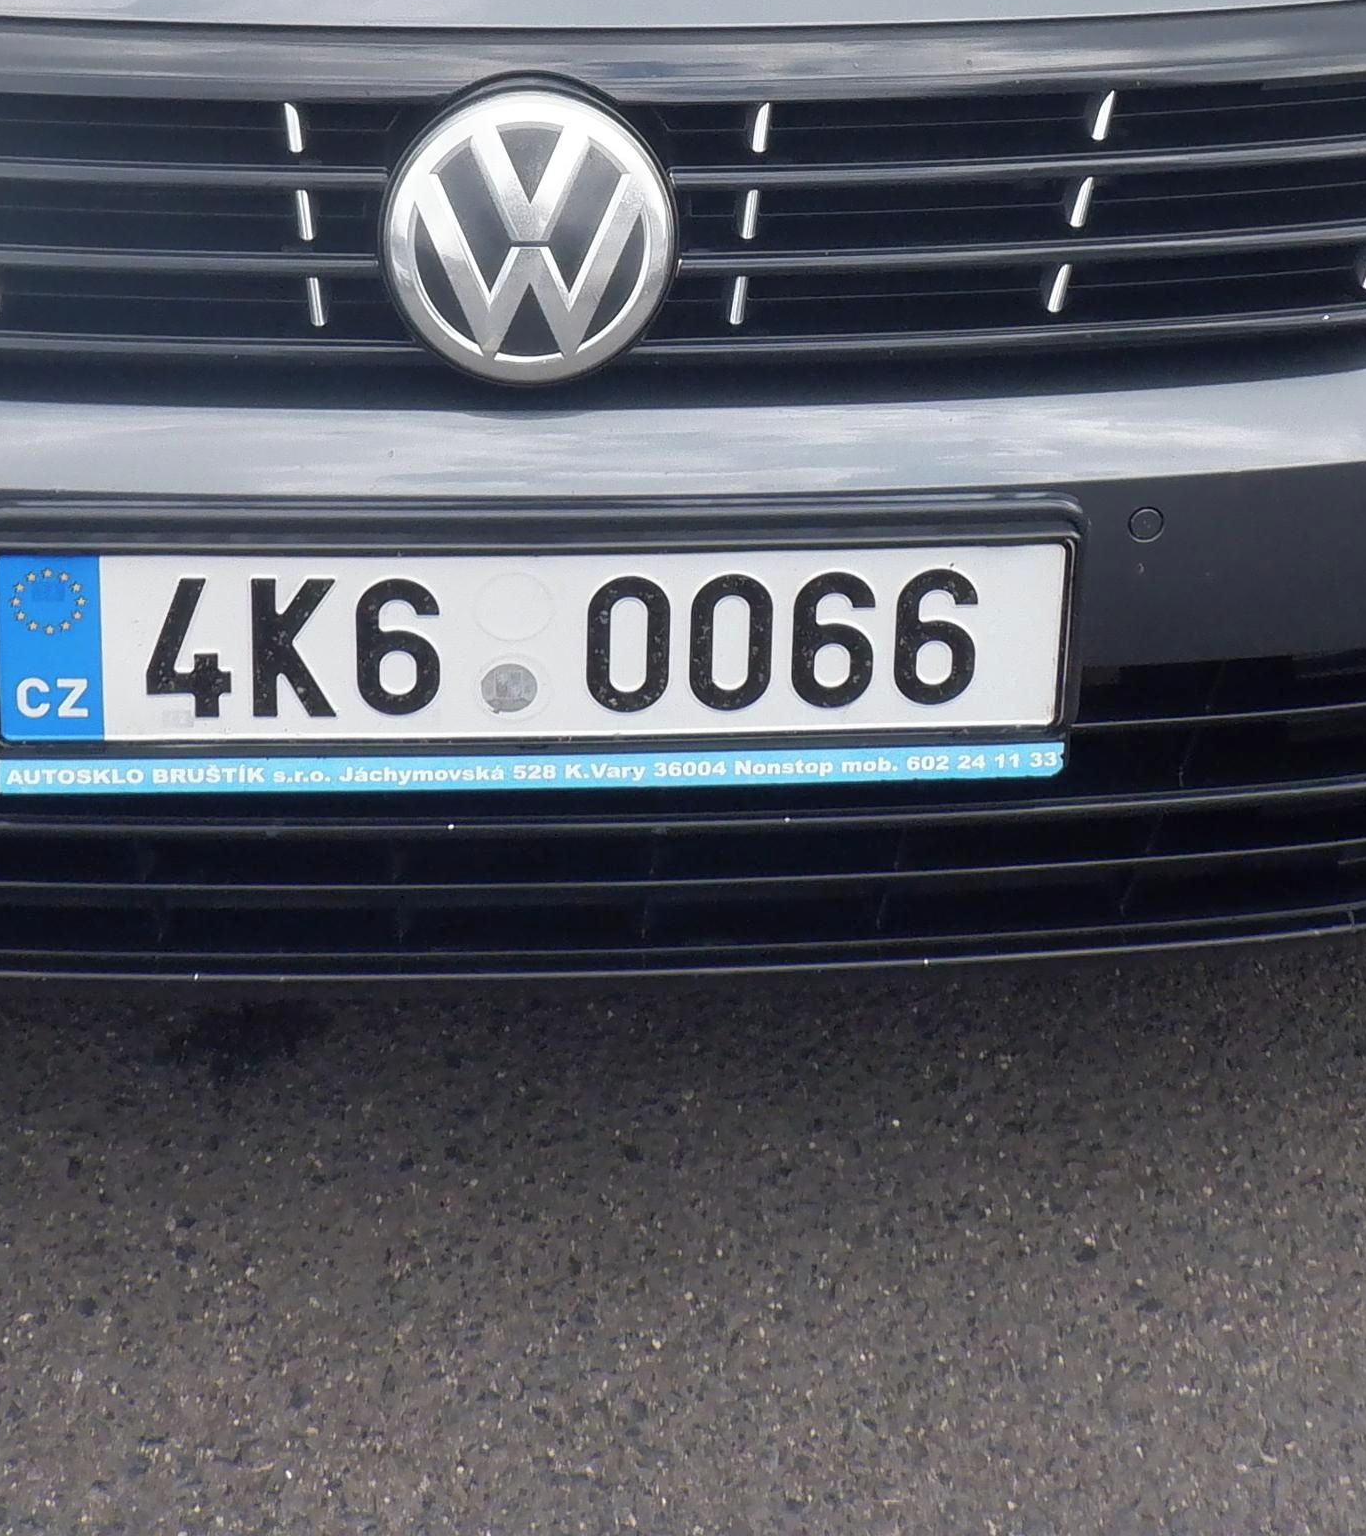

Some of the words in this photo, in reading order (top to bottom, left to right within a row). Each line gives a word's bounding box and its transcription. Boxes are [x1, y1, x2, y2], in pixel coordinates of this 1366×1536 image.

[146, 577, 441, 718] 4K6
[585, 568, 979, 714] 0066
[16, 677, 89, 718] CZ
[6, 768, 145, 786] AUTOSKLO
[152, 764, 264, 785] BRUŠTÍK
[272, 768, 332, 784] s.r.o.
[339, 765, 504, 786] Jáchymovská
[513, 764, 556, 780] 528
[565, 763, 645, 782] K.Vary
[654, 761, 726, 777] 36004
[734, 759, 833, 778] Nonstop
[841, 757, 898, 774] mob.
[906, 755, 950, 771] 602
[956, 753, 986, 770] 24
[993, 753, 1021, 769] 11
[1029, 751, 1058, 768] 33
